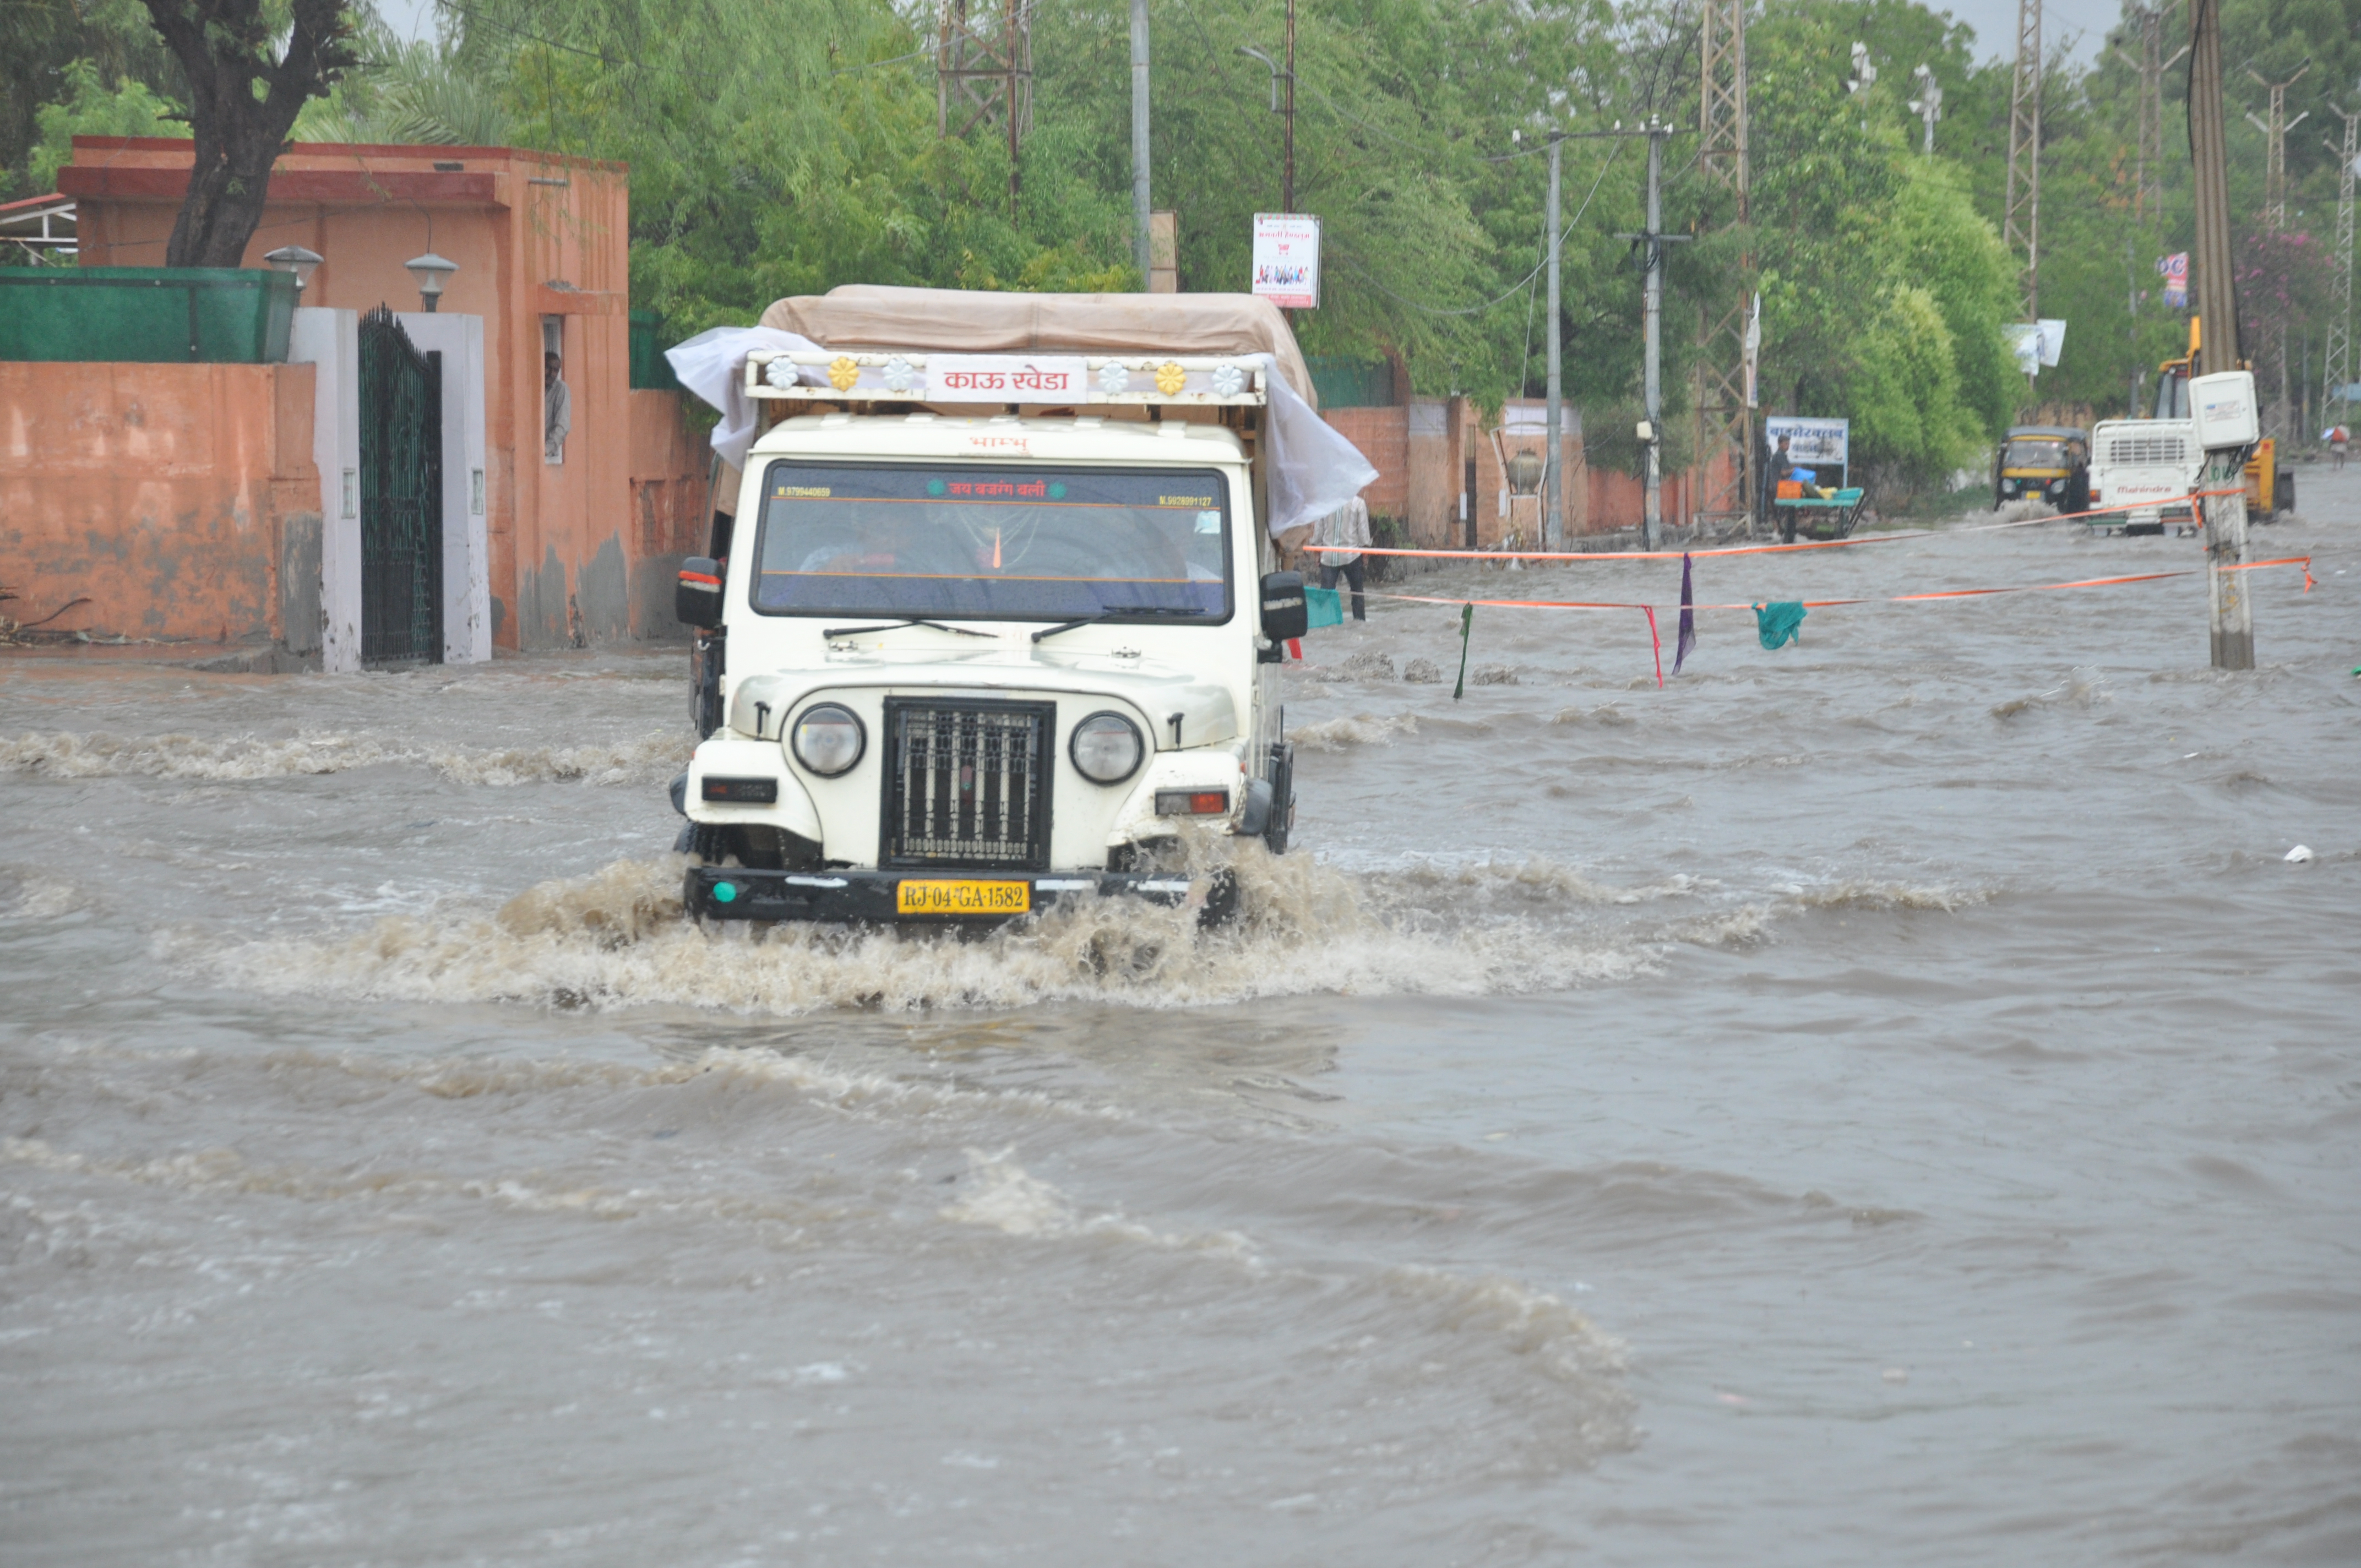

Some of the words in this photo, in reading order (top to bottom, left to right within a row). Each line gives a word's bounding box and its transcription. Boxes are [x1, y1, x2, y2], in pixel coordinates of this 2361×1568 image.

[944, 372, 1005, 389] काऊ
[948, 482, 972, 495] जय
[975, 480, 1014, 496] बजरंग
[1017, 480, 1046, 497] बली
[2117, 486, 2172, 494] Mahindra
